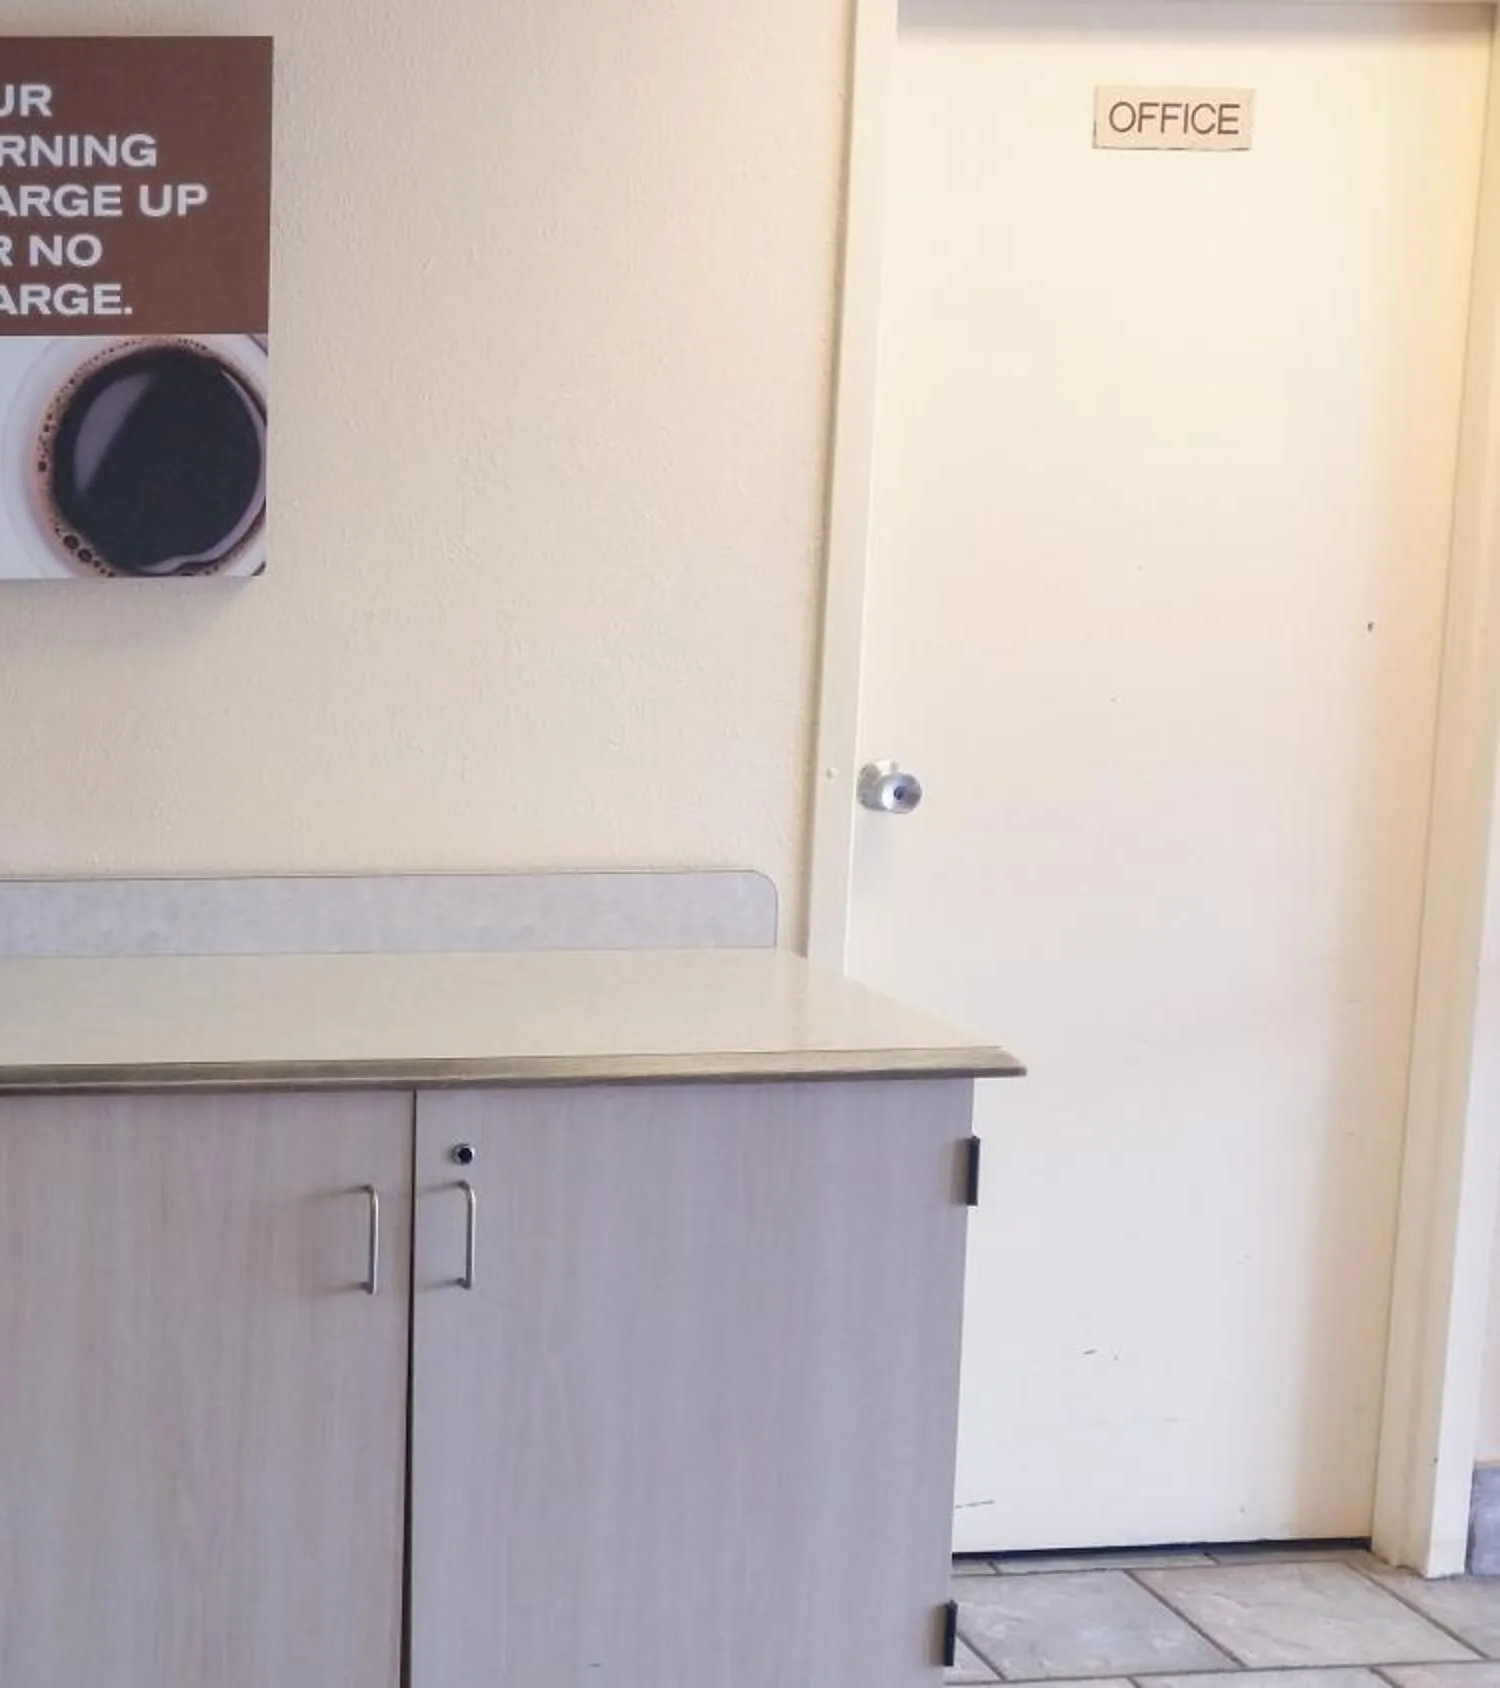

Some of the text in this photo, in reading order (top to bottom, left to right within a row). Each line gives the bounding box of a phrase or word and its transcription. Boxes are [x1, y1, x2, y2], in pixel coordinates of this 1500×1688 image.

[1108, 101, 1240, 135] OFFICE
[139, 184, 208, 217] UP
[29, 234, 103, 267] NO
